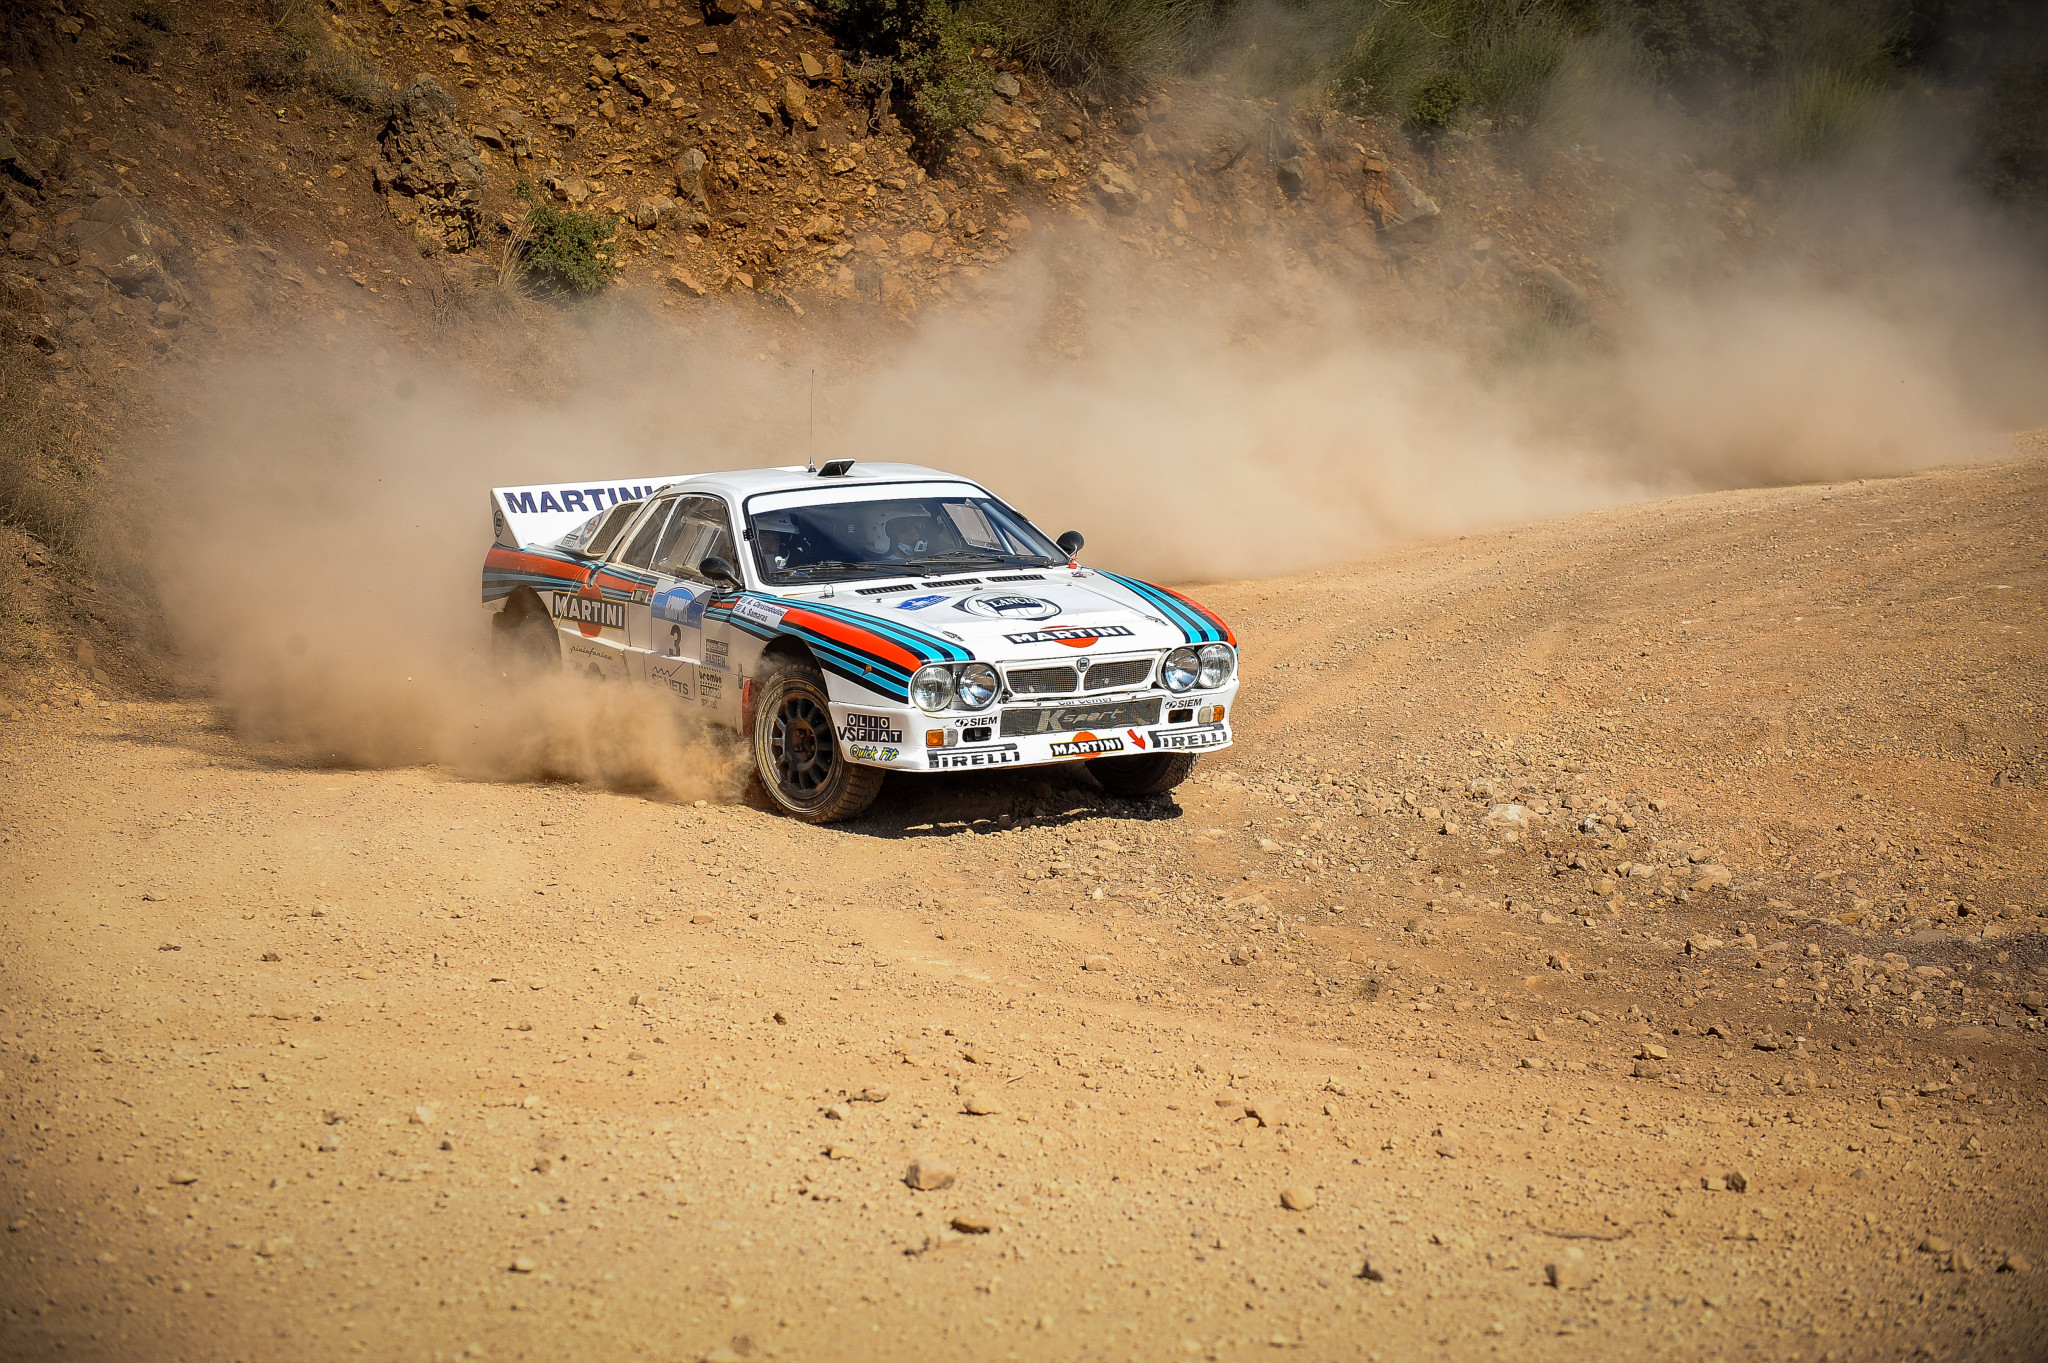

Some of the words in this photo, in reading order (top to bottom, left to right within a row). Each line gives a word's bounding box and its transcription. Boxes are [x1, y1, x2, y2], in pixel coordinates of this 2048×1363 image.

[989, 596, 1039, 608] LANCIA
[555, 595, 623, 627] MARTINI
[669, 624, 682, 657] 3
[1012, 626, 1129, 643] MARTINI
[1177, 698, 1202, 708] SIEM
[848, 715, 888, 729] OLIO
[970, 717, 998, 726] SIEM
[1148, 723, 1228, 748] PIRELLI
[850, 744, 877, 761] Quick
[879, 747, 899, 761] Fit
[1053, 737, 1123, 756] MARTINI
[927, 743, 1020, 768] PIRELLI
